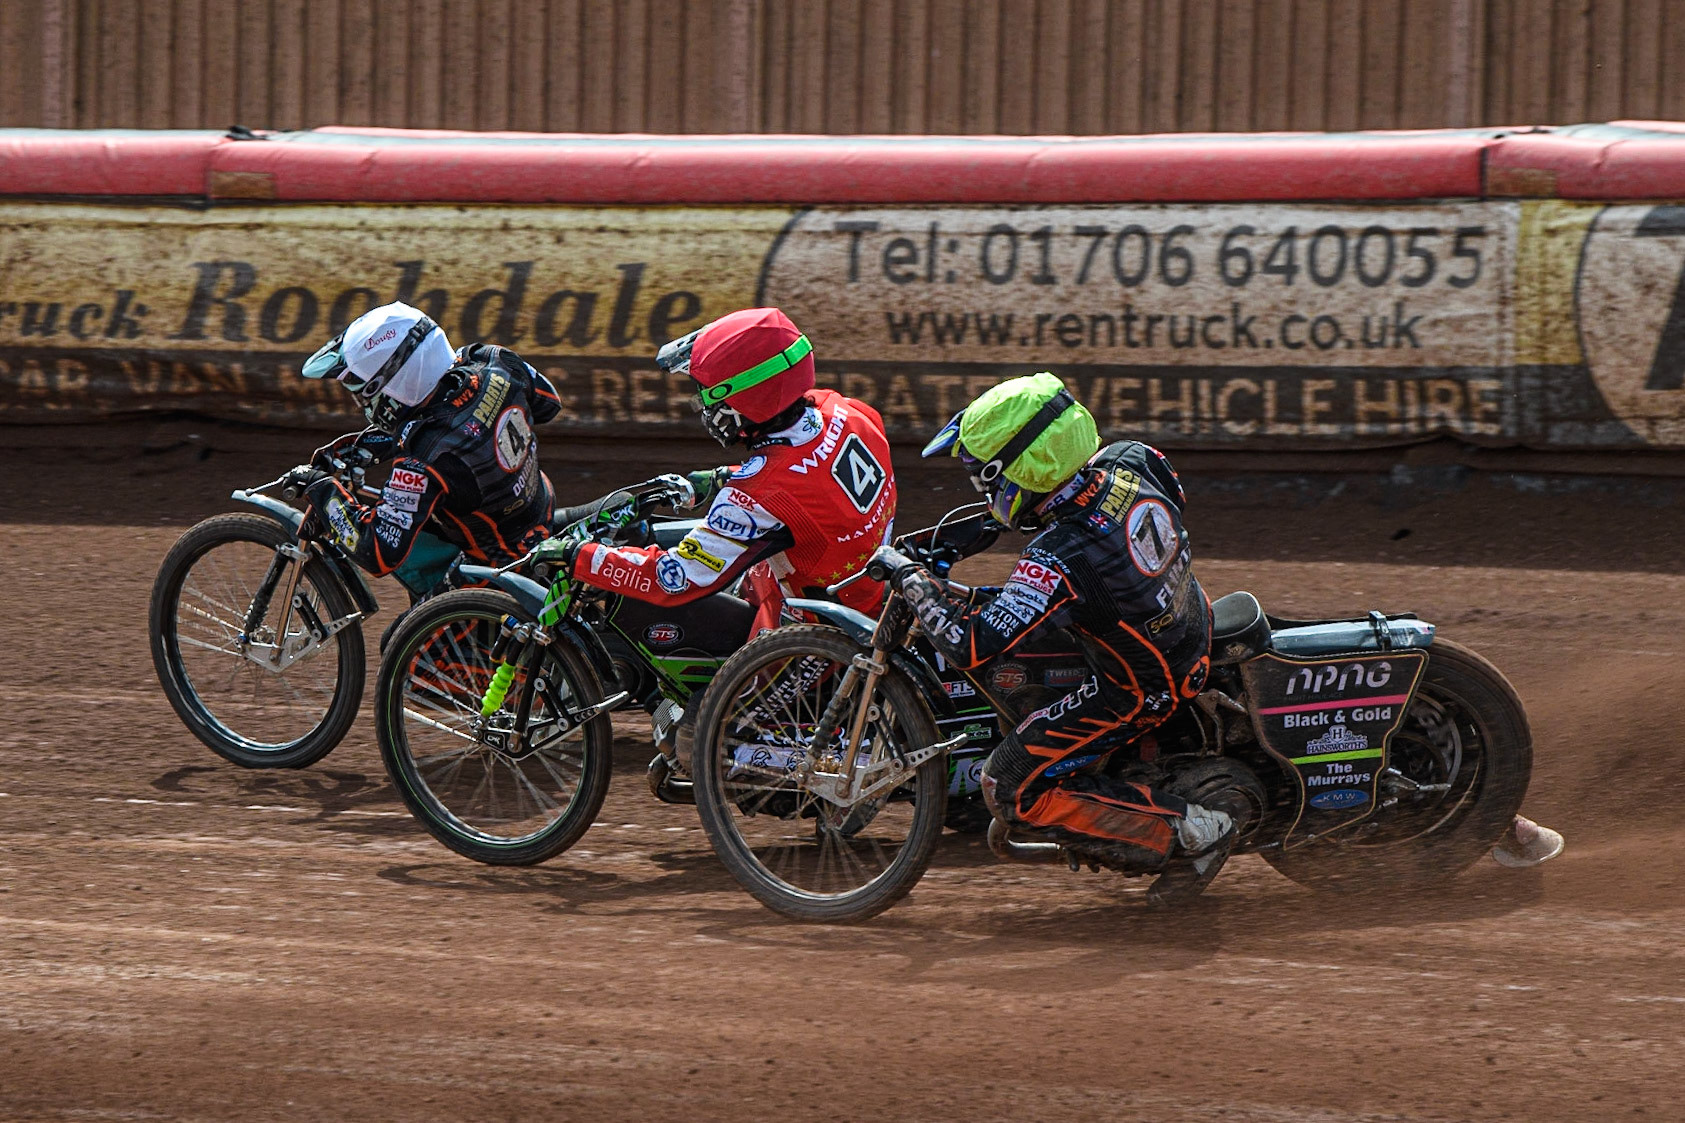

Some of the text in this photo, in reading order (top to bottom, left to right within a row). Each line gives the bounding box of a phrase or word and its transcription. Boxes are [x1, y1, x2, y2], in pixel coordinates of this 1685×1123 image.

[835, 220, 1487, 288] Tel: 01706 640055
[363, 327, 397, 351] Dougy
[885, 302, 1423, 350] www.rentruck.co.uk
[473, 372, 505, 424] PARRYS
[1065, 376, 1339, 436] VEHICLE
[1355, 378, 1500, 435] HIRE
[506, 420, 527, 457] 4
[788, 403, 848, 475] WRIGHT
[393, 471, 426, 487] NGK
[848, 449, 878, 497] 4
[730, 490, 757, 510] NGK
[837, 472, 895, 543] MANCHESTE
[712, 516, 747, 536] ATPI
[602, 562, 652, 593] agilia
[1013, 562, 1059, 589] NGK
[1030, 580, 1053, 594] PLUGS
[650, 630, 676, 638] STS
[981, 611, 1013, 638] SKIPS
[994, 672, 1024, 684] STS
[1284, 707, 1392, 729] Black & Gold
[1307, 773, 1371, 787] Murrays
[1326, 763, 1353, 774] The
